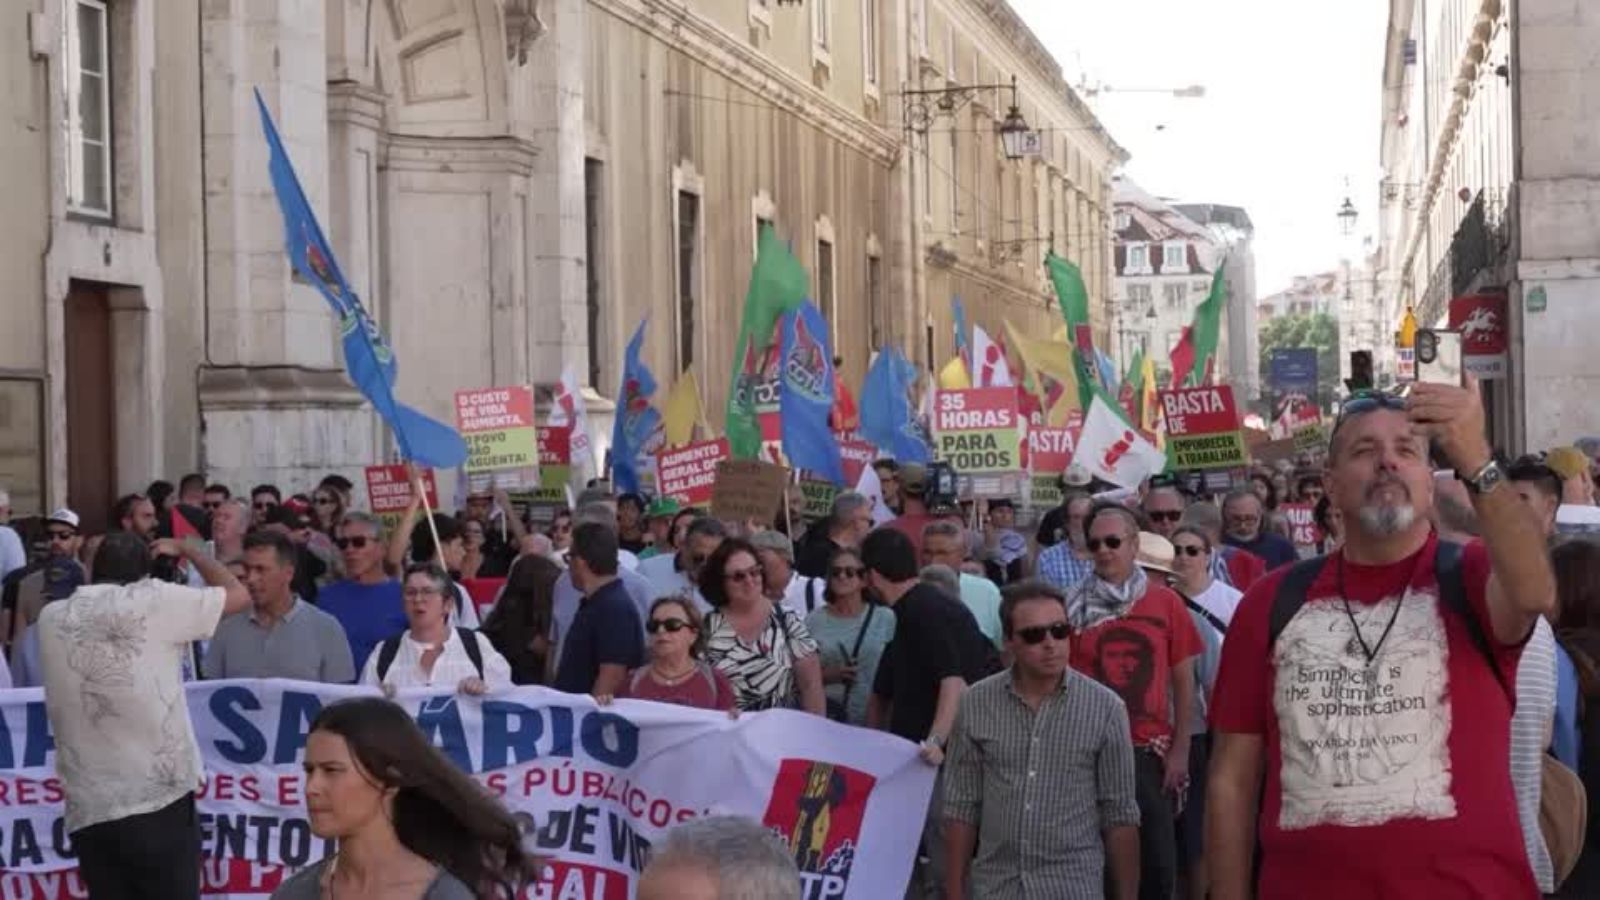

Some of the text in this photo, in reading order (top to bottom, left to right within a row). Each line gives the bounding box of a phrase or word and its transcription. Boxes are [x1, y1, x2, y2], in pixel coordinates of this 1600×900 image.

[941, 393, 965, 410] 35
[1164, 391, 1225, 417] BASTA
[941, 409, 1010, 429] HORAS
[1168, 416, 1187, 434] DE
[942, 434, 996, 451] PARA
[1028, 430, 1074, 453] ASTA
[944, 451, 1011, 469] TODOS
[1390, 666, 1401, 679] is
[1285, 685, 1310, 702] the
[1382, 732, 1418, 748] VINCI
